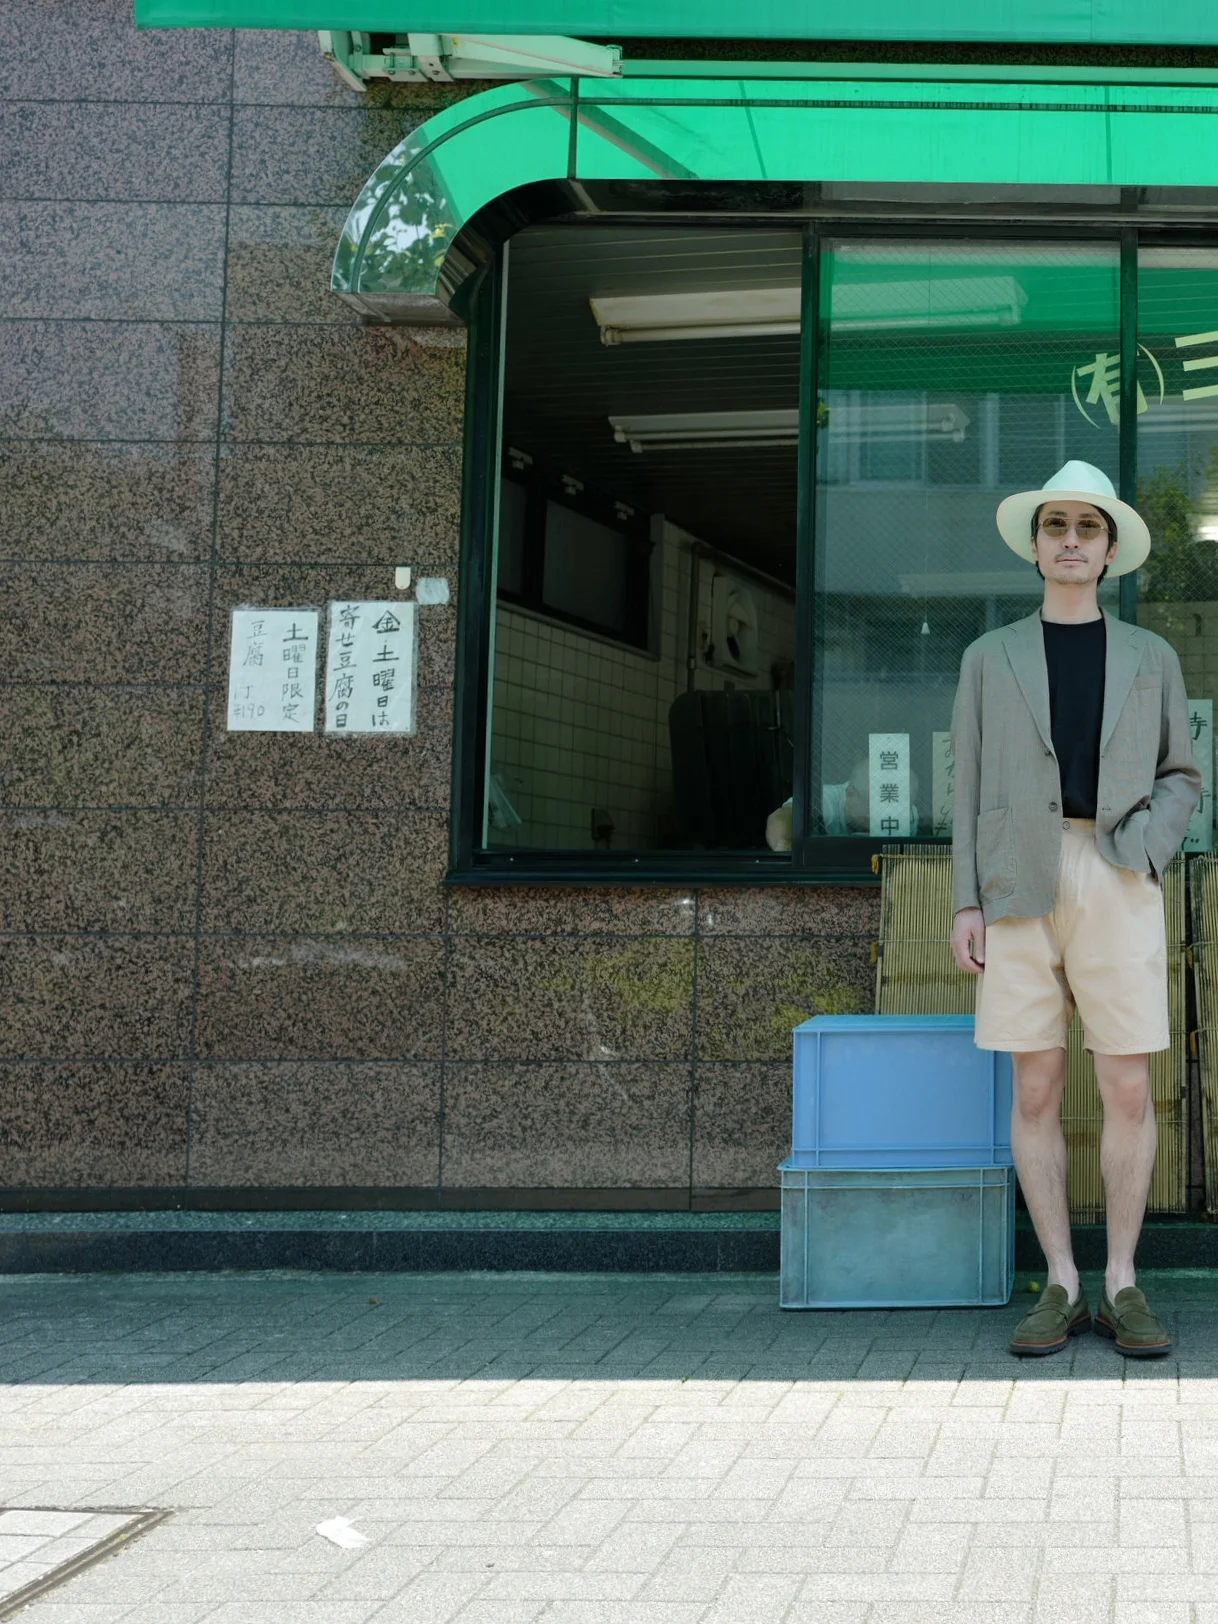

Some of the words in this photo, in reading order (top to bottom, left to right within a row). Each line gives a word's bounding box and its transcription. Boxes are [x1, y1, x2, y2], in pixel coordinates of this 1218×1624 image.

[242, 619, 268, 667] 豆腐
[281, 623, 309, 724] 土曜日限定
[328, 604, 361, 728] 寄せ豆腐の日
[880, 751, 899, 836] 営業中
